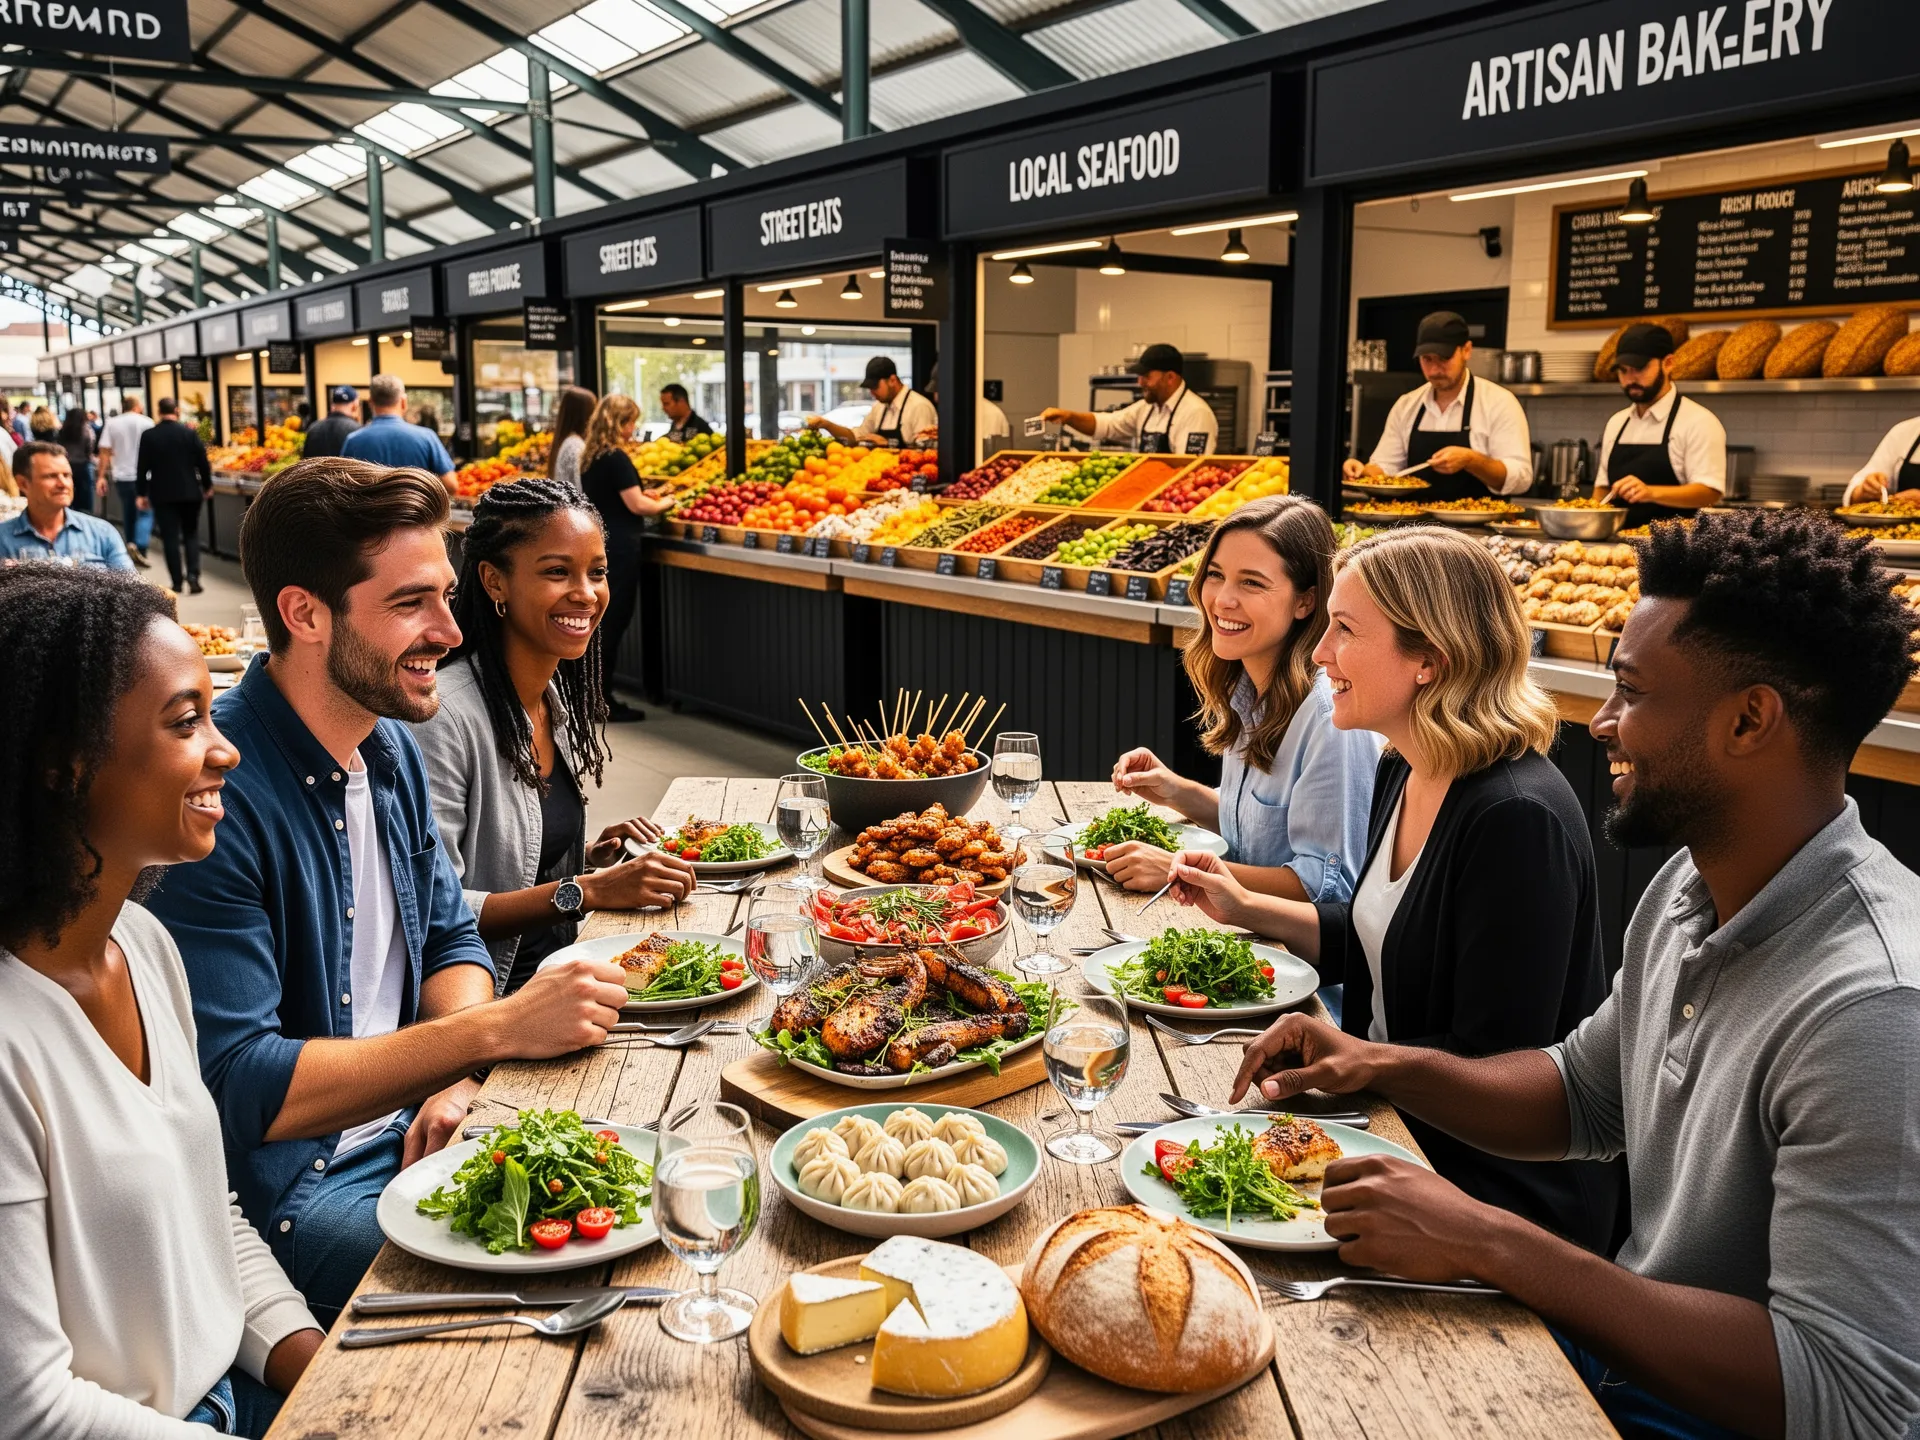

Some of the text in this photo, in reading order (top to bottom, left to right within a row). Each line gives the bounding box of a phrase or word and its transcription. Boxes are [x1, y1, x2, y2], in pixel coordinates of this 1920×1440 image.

[1462, 29, 1625, 120] ARTISAN
[1009, 128, 1180, 203] LOCAL SEAFOOD
[760, 196, 843, 247] STREET EATS
